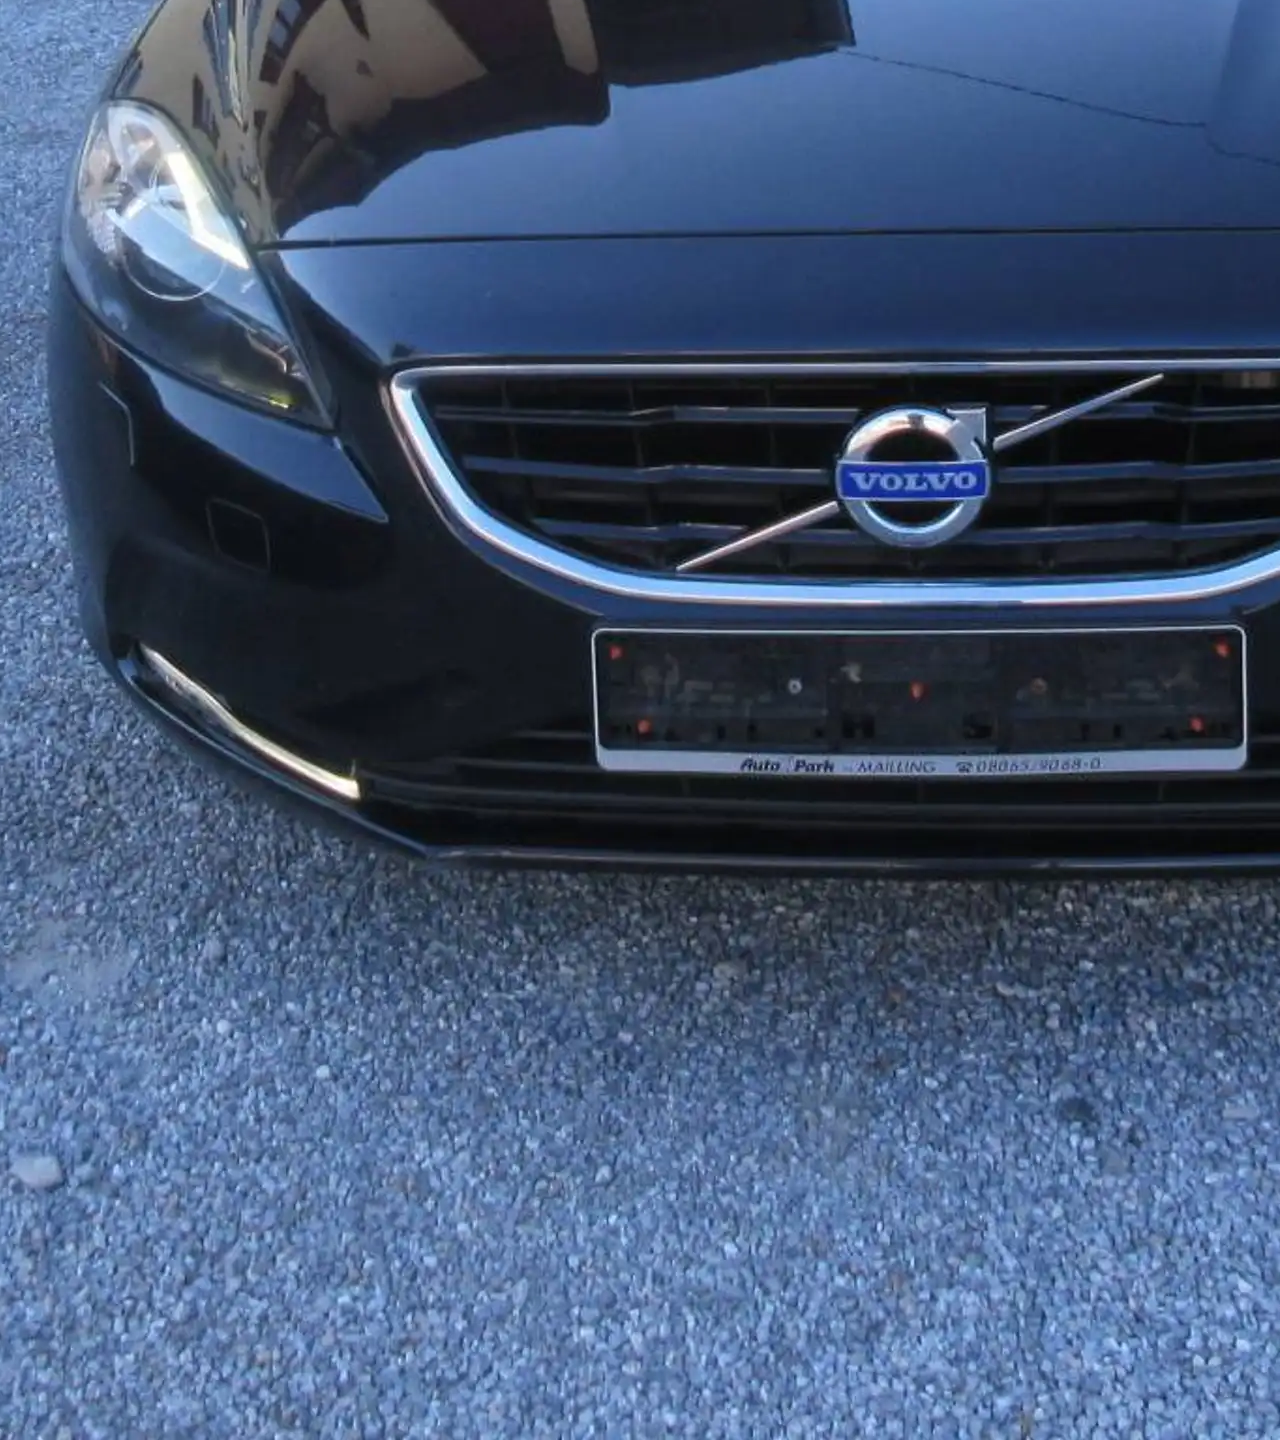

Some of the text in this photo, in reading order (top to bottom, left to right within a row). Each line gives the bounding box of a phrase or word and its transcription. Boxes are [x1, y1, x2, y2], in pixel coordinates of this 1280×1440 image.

[849, 471, 978, 493] VOLVO
[740, 757, 781, 773] Auto
[794, 758, 835, 773] Park
